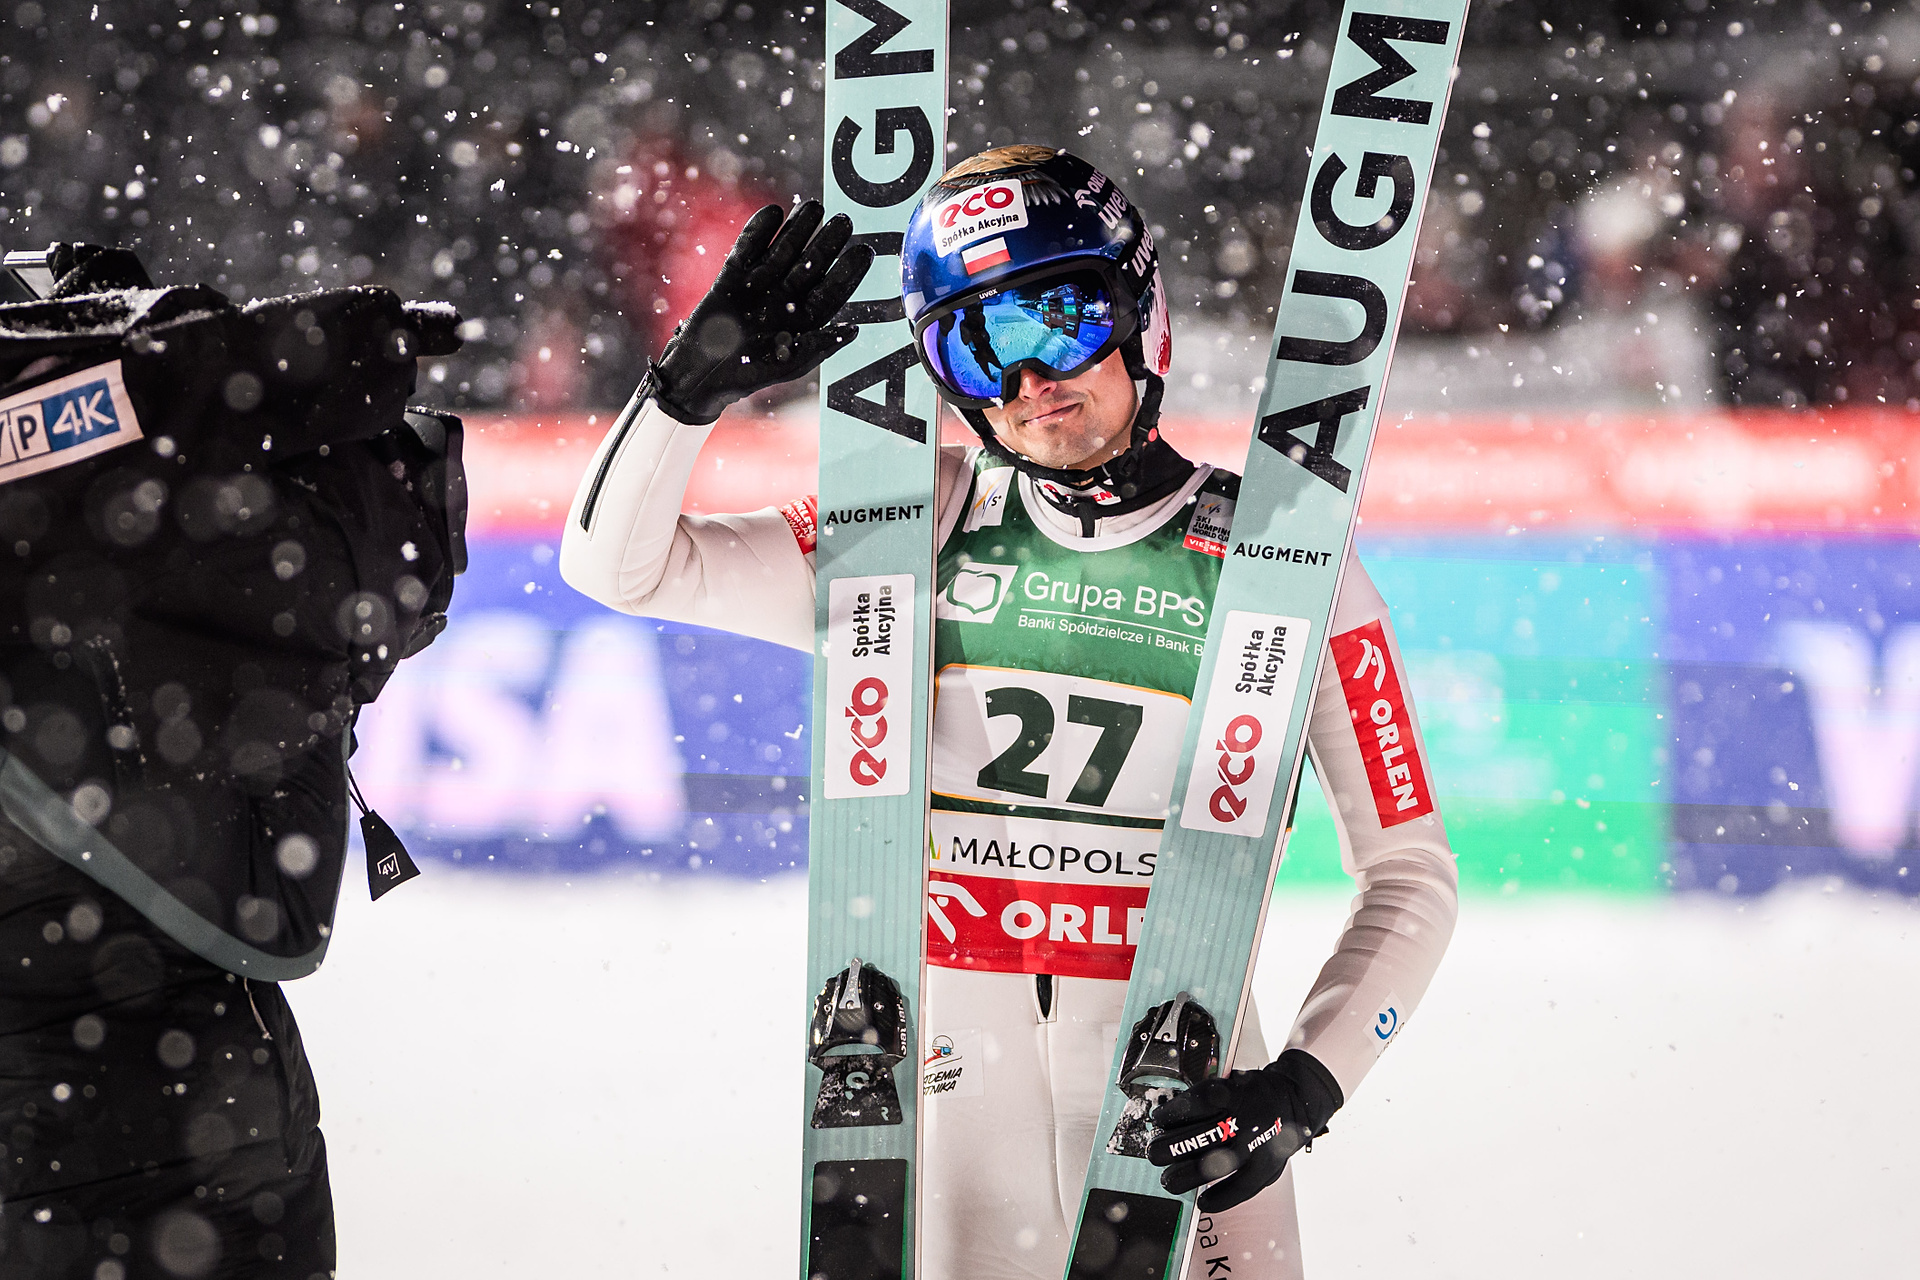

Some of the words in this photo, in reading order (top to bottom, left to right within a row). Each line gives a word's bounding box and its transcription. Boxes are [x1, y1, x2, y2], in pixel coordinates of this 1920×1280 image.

[1098, 187, 1128, 230] uve
[941, 226, 976, 248] Spółka
[978, 213, 1020, 231] Akcyjna
[978, 288, 998, 300] uvex
[52, 388, 116, 436] 4K
[825, 504, 924, 525] AUGMENT
[1192, 528, 1217, 539] WORLD
[1195, 515, 1212, 525] SKI
[1232, 542, 1332, 567] AUGMENT
[874, 584, 896, 656] Akcyjna
[1023, 571, 1126, 613] Grupa
[1133, 585, 1206, 628] BPS
[851, 592, 873, 658] Spółka
[1018, 614, 1056, 630] Banki
[1058, 617, 1144, 644] Spółdzielcze
[1155, 634, 1190, 654] Bank
[1235, 629, 1265, 694] Spółka
[1256, 625, 1288, 697] Akcyjna
[976, 686, 1144, 808] 27
[1369, 698, 1419, 813] ORLEN
[951, 836, 1158, 877] MAŁOPOLS
